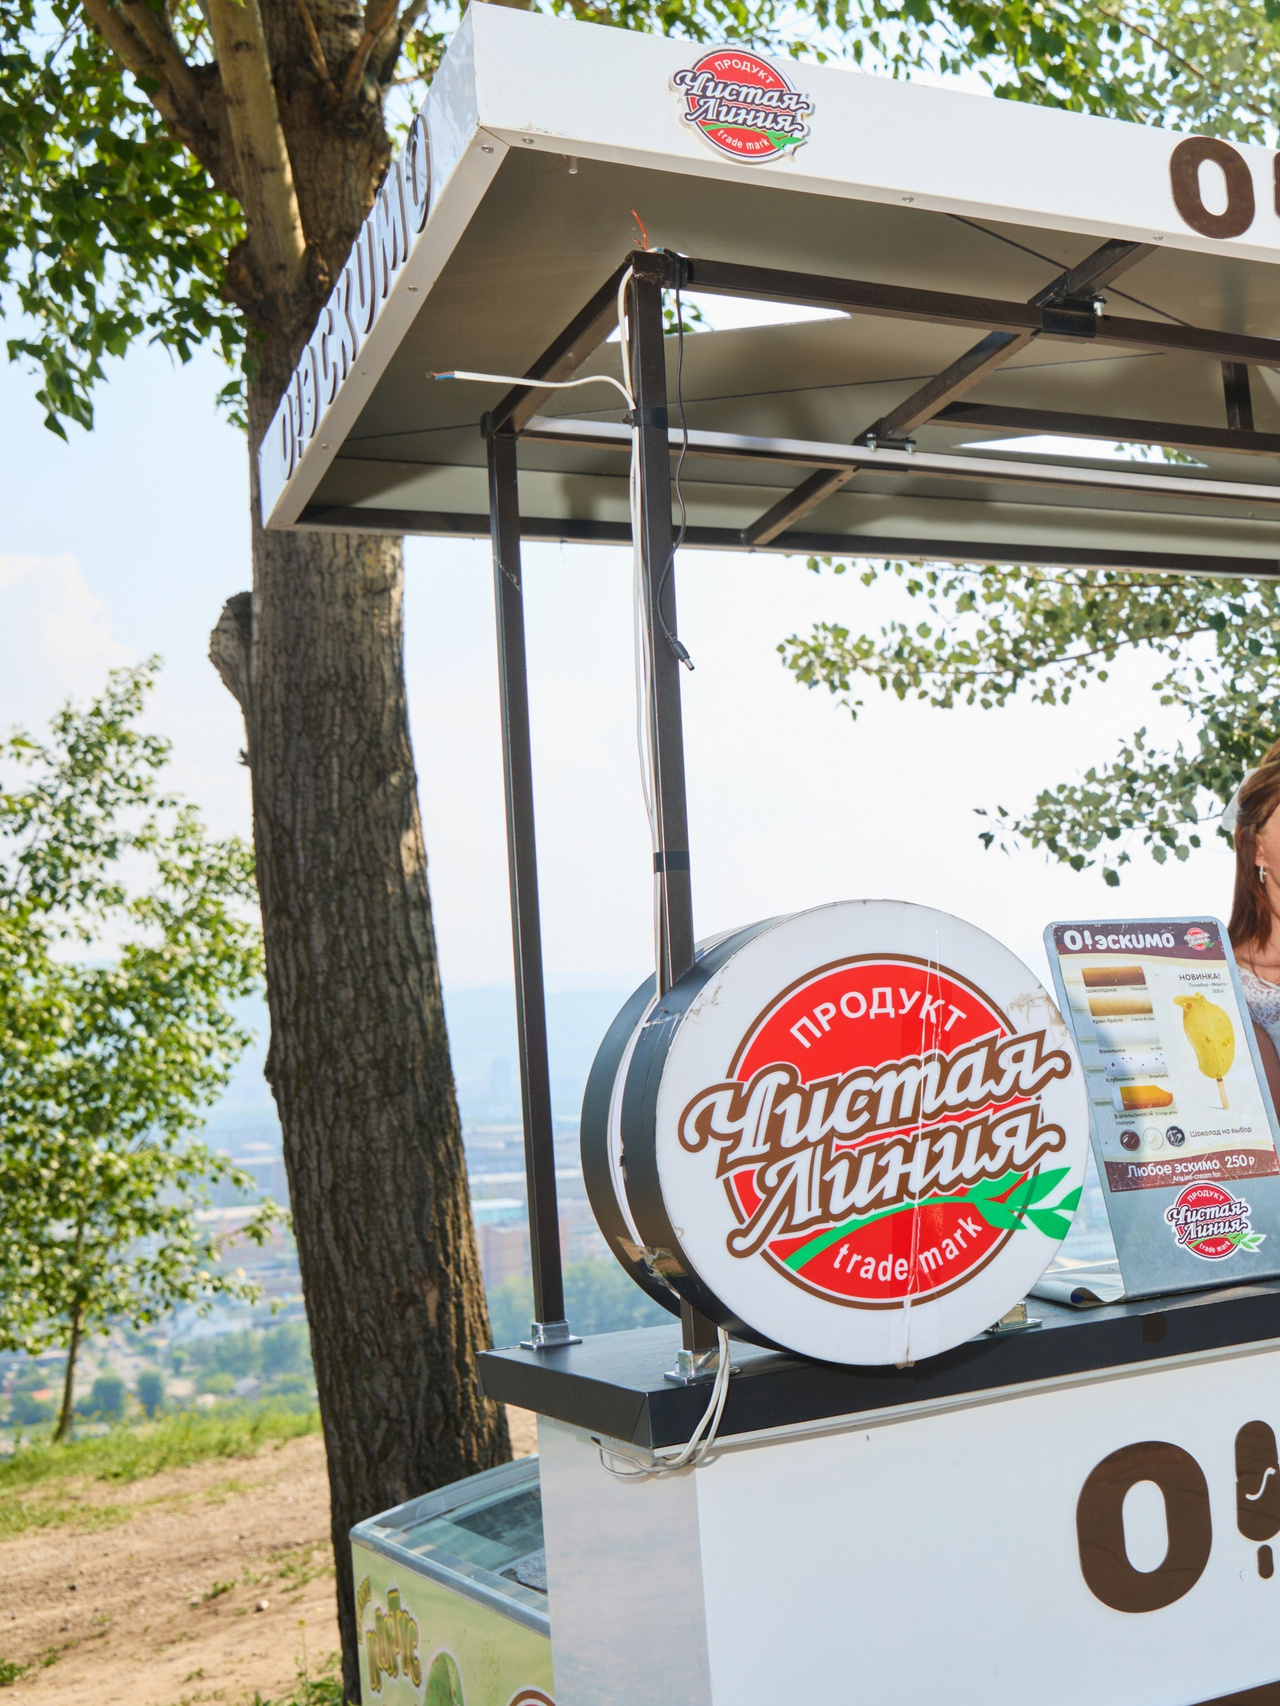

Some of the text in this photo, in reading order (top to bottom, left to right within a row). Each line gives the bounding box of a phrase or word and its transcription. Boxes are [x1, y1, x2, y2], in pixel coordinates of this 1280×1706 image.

[714, 59, 775, 84] ПРОДУКТ
[675, 70, 809, 111] Чистая
[685, 99, 804, 133] Линия
[717, 129, 770, 150] trade mark
[1178, 973, 1221, 981] НОВИНКА!
[789, 986, 967, 1049] ПРОДУКТ
[679, 1031, 1070, 1174] Чистая
[1189, 1129, 1221, 1138] Шоколад
[1231, 1126, 1252, 1135] выбор
[727, 1104, 1065, 1257] Линия
[1127, 1164, 1172, 1178] Любое
[1174, 1160, 1220, 1172] эскимо
[1187, 1189, 1225, 1203] ПРОДУКТ
[1167, 1201, 1248, 1226] Чистая
[1178, 1218, 1248, 1244] Линия
[833, 1215, 984, 1281] trade mark
[1199, 1240, 1231, 1253] trade mark
